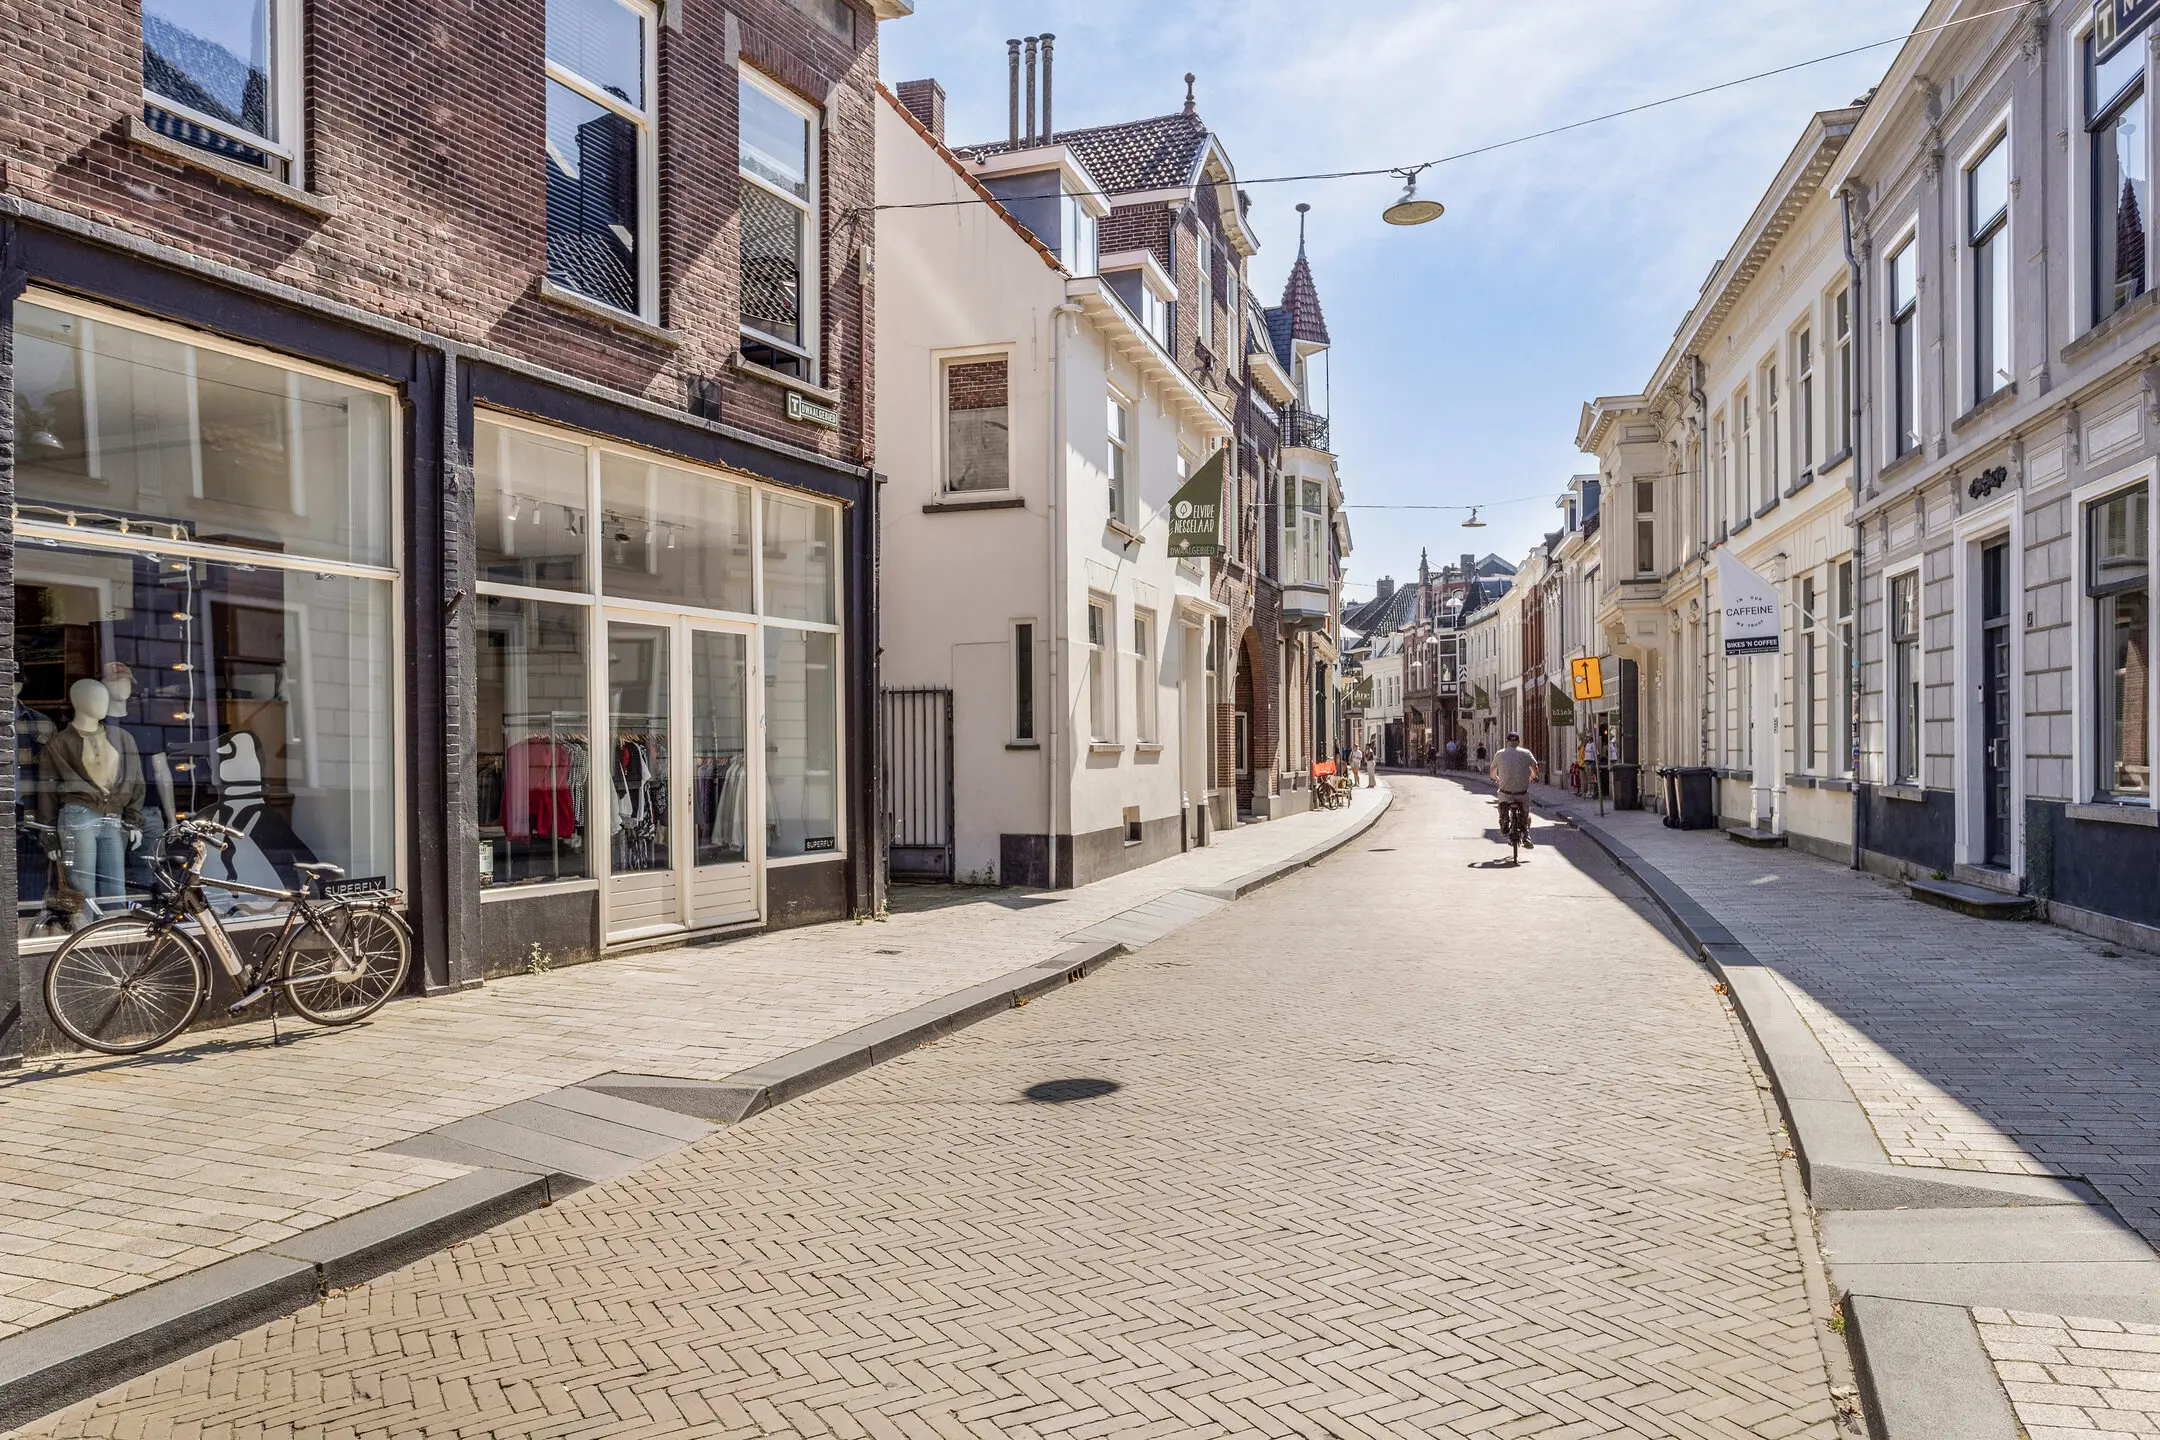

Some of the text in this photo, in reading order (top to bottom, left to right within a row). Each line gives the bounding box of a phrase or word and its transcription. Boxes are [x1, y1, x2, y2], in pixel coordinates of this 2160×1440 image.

[2123, 0, 2142, 17] N
[1193, 504, 1215, 519] ELVIRE
[1174, 519, 1215, 534] NESSELAAR
[1726, 605, 1773, 616] CAFFEINE
[1726, 641, 1746, 649] BIKES
[1753, 639, 1778, 647] COFFEE
[806, 840, 833, 849] SUPERFLY
[325, 880, 382, 895] SUPERFLY
